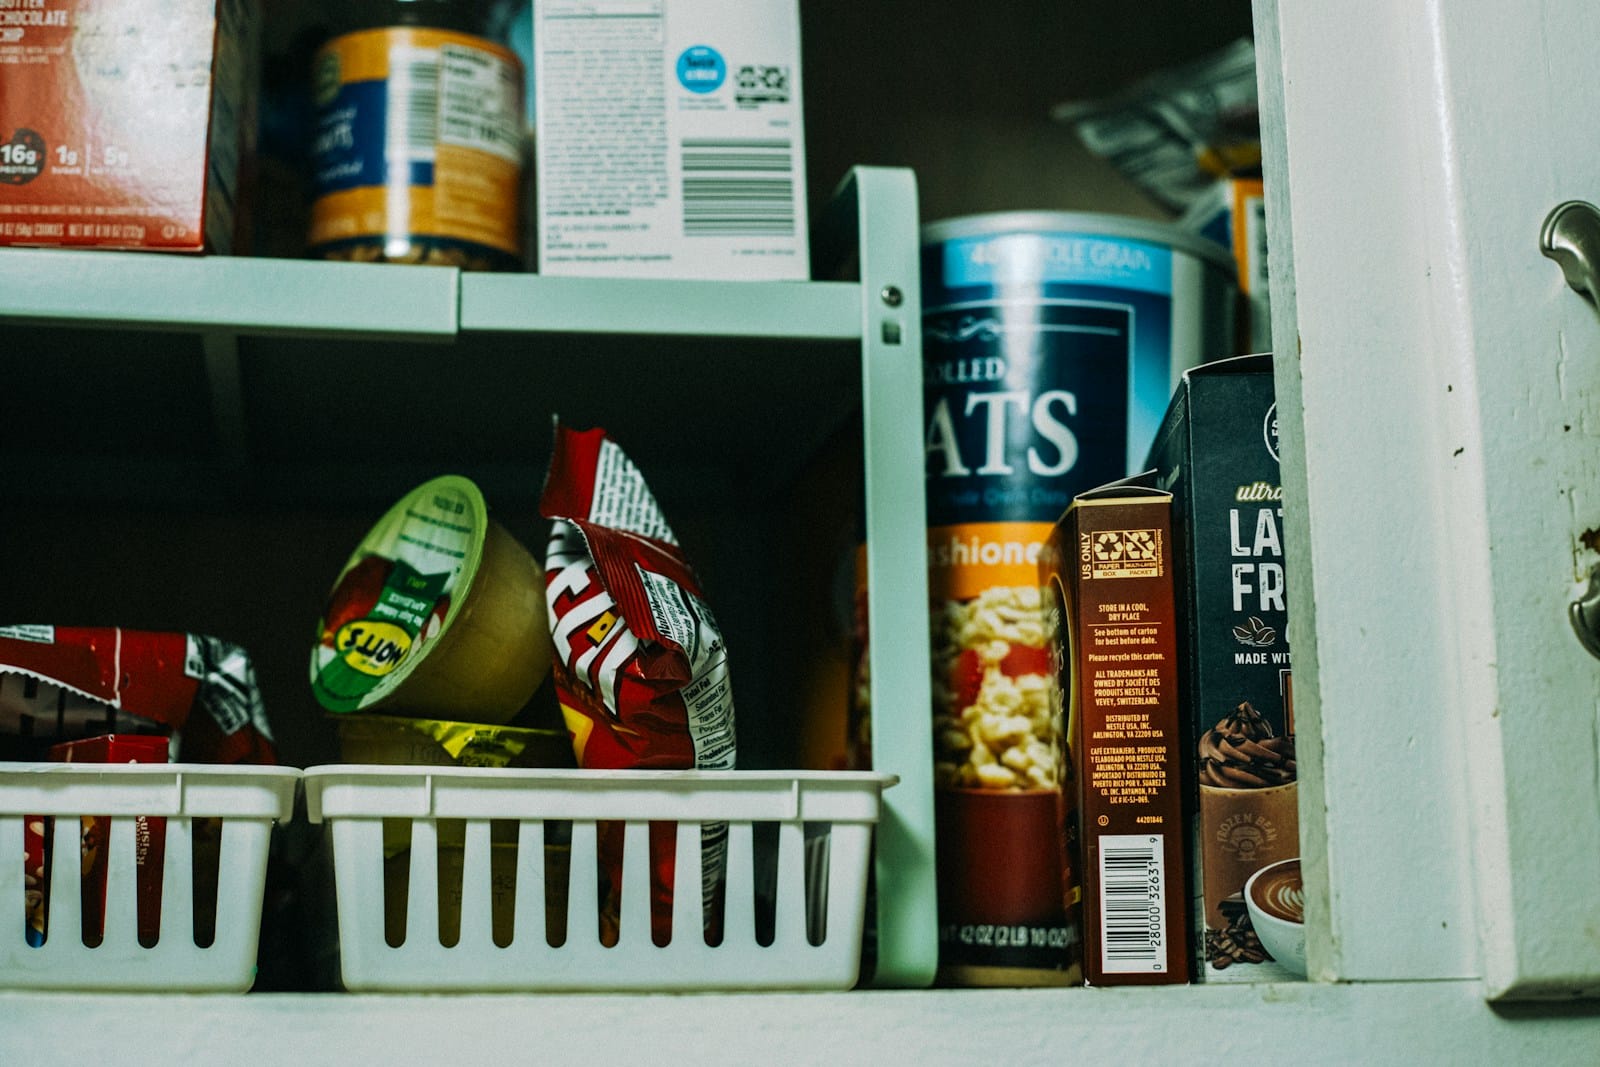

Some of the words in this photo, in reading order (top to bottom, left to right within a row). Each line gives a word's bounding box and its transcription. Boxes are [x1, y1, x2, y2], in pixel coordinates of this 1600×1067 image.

[1, 143, 37, 165] 16g
[55, 144, 78, 166] 1g
[926, 390, 1078, 477] ATS
[1081, 533, 1091, 561] ONLY
[1082, 563, 1092, 580] US
[1098, 603, 1117, 612] STORE
[1119, 603, 1125, 612] IN
[1126, 603, 1131, 611] A
[1132, 602, 1149, 612] COOL,
[1108, 613, 1120, 621] DRY
[1122, 612, 1140, 620] PLACE
[1094, 628, 1105, 636] See
[1106, 627, 1129, 636] bottom
[1130, 627, 1137, 635] of
[1137, 627, 1158, 635] carton
[1095, 637, 1104, 645] for
[1105, 637, 1119, 645] best
[1120, 637, 1140, 645] before
[1141, 636, 1158, 644] date.
[1089, 654, 1108, 662] Please
[1109, 653, 1130, 662] recycle
[1131, 653, 1142, 661] this
[1143, 652, 1165, 661] carton.
[1235, 653, 1267, 664] MADE
[1106, 669, 1146, 678] TRADEMARKS
[1146, 669, 1158, 677] ARE
[1093, 679, 1115, 687] OWNED
[1116, 679, 1124, 687] BY
[1125, 678, 1148, 686] SOCIÉTÉ
[1149, 678, 1160, 686] DES
[1094, 688, 1123, 696] PRODUITS
[1124, 687, 1145, 696] NESTLÉ
[1095, 698, 1116, 707] VEVEY,
[1117, 697, 1160, 705] SWITZERLAND.
[1105, 714, 1141, 722] DISTRIBUTED
[1106, 722, 1125, 730] NESTLÉ
[1126, 722, 1139, 730] USA,
[1093, 731, 1126, 739] ARLINGTON,
[1135, 730, 1151, 738] 22209
[1137, 746, 1166, 754] PRODUCIDO
[1095, 755, 1124, 763] ELABORADO
[1127, 763, 1133, 771] VA
[1126, 771, 1158, 779] DISTRIBUIDO
[1093, 780, 1112, 788] PUERTO
[1113, 780, 1125, 788] RICO
[1136, 816, 1163, 824] 44201846
[1148, 861, 1160, 900] 32631
[1150, 906, 1161, 946] 28000
[1010, 926, 1028, 946] LB
